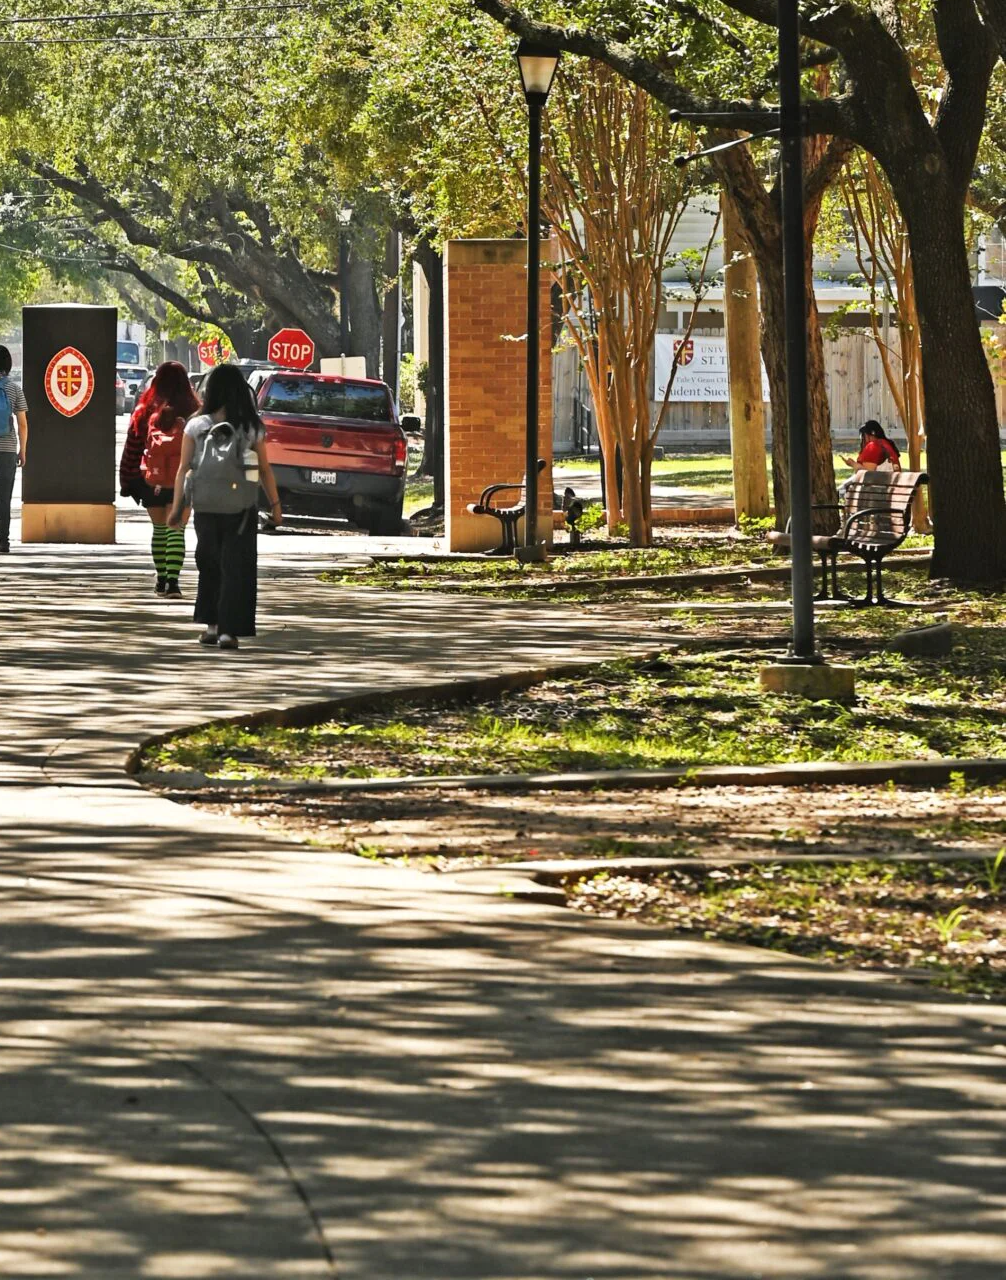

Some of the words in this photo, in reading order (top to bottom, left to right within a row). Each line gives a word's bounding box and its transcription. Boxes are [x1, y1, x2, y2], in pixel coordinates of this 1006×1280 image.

[200, 344, 226, 359] STO
[271, 342, 311, 360] STOP
[701, 356, 717, 365] ST.
[658, 385, 701, 397] Sudent
[704, 385, 729, 397] Succ
